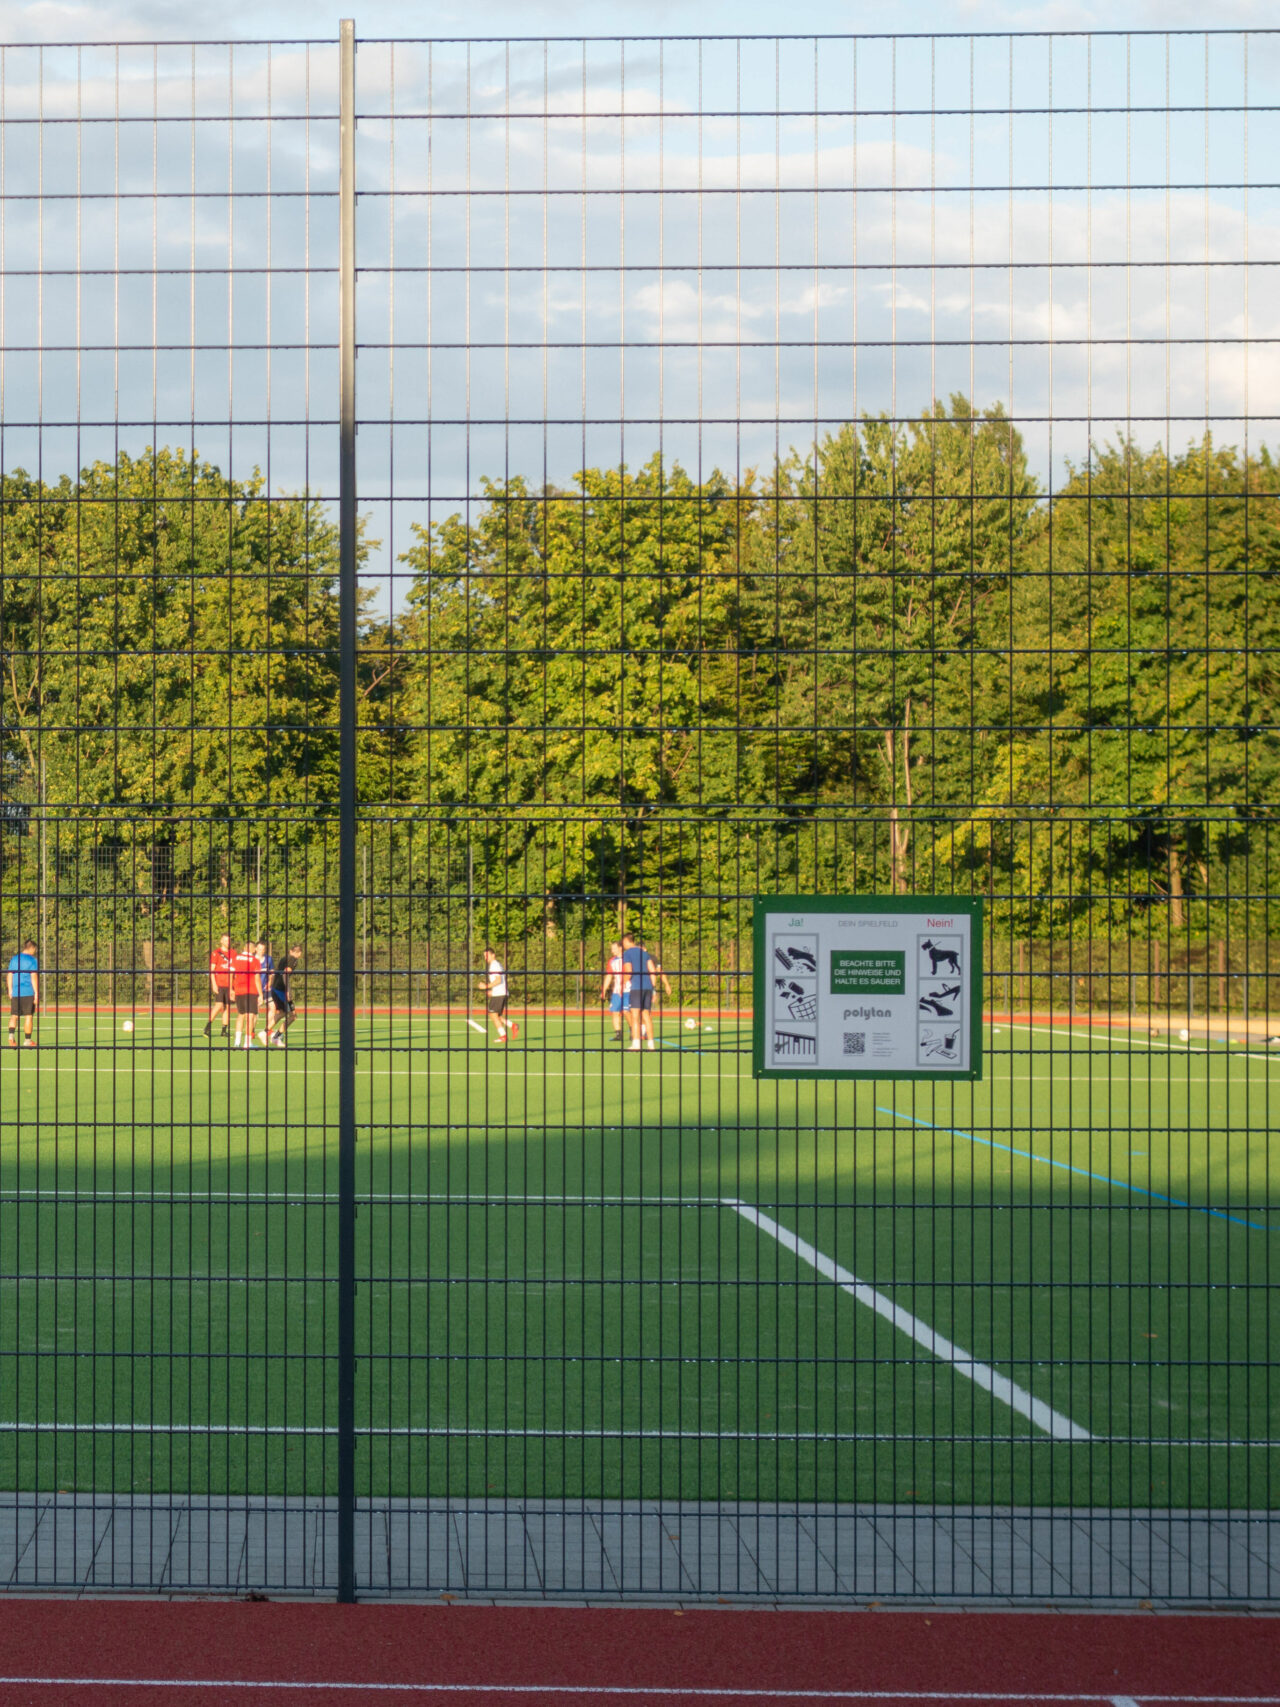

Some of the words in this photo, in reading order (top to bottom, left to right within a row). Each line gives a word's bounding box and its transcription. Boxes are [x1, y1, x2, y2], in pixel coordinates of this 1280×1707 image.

[788, 918, 804, 927] Ja!
[838, 920, 856, 928] DEIN
[858, 920, 898, 928] SPIELFELD
[927, 918, 954, 928] Nein!
[843, 1006, 892, 1021] polytan
